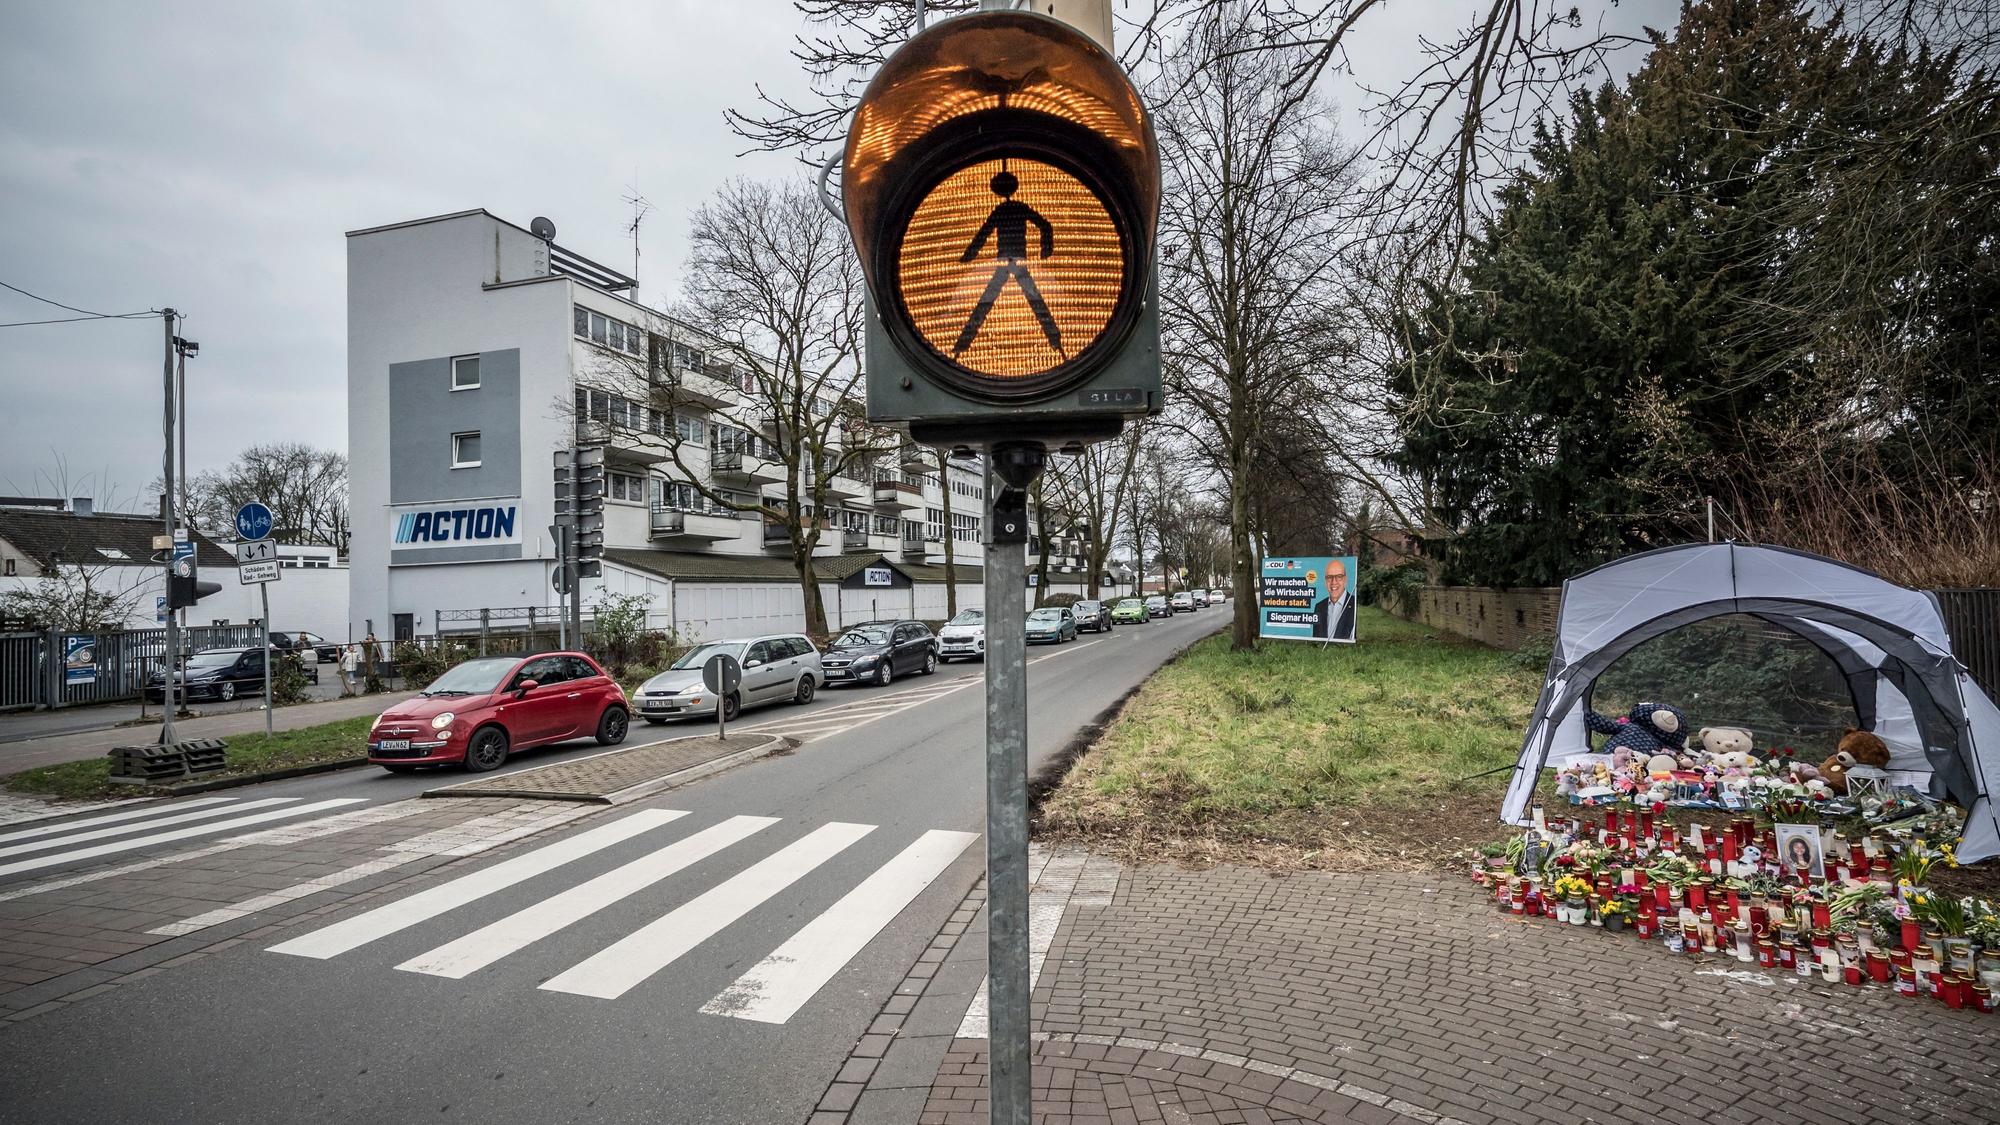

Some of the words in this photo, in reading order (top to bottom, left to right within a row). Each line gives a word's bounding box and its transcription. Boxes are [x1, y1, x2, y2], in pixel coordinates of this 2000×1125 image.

[410, 507, 516, 542] ACTION
[870, 571, 890, 582] ACTION
[1276, 588, 1314, 597] Wirtschaft
[1264, 598, 1288, 606] wieder
[1270, 613, 1301, 622] Siegmar
[1302, 614, 1318, 622] Heß
[68, 637, 77, 650] P
